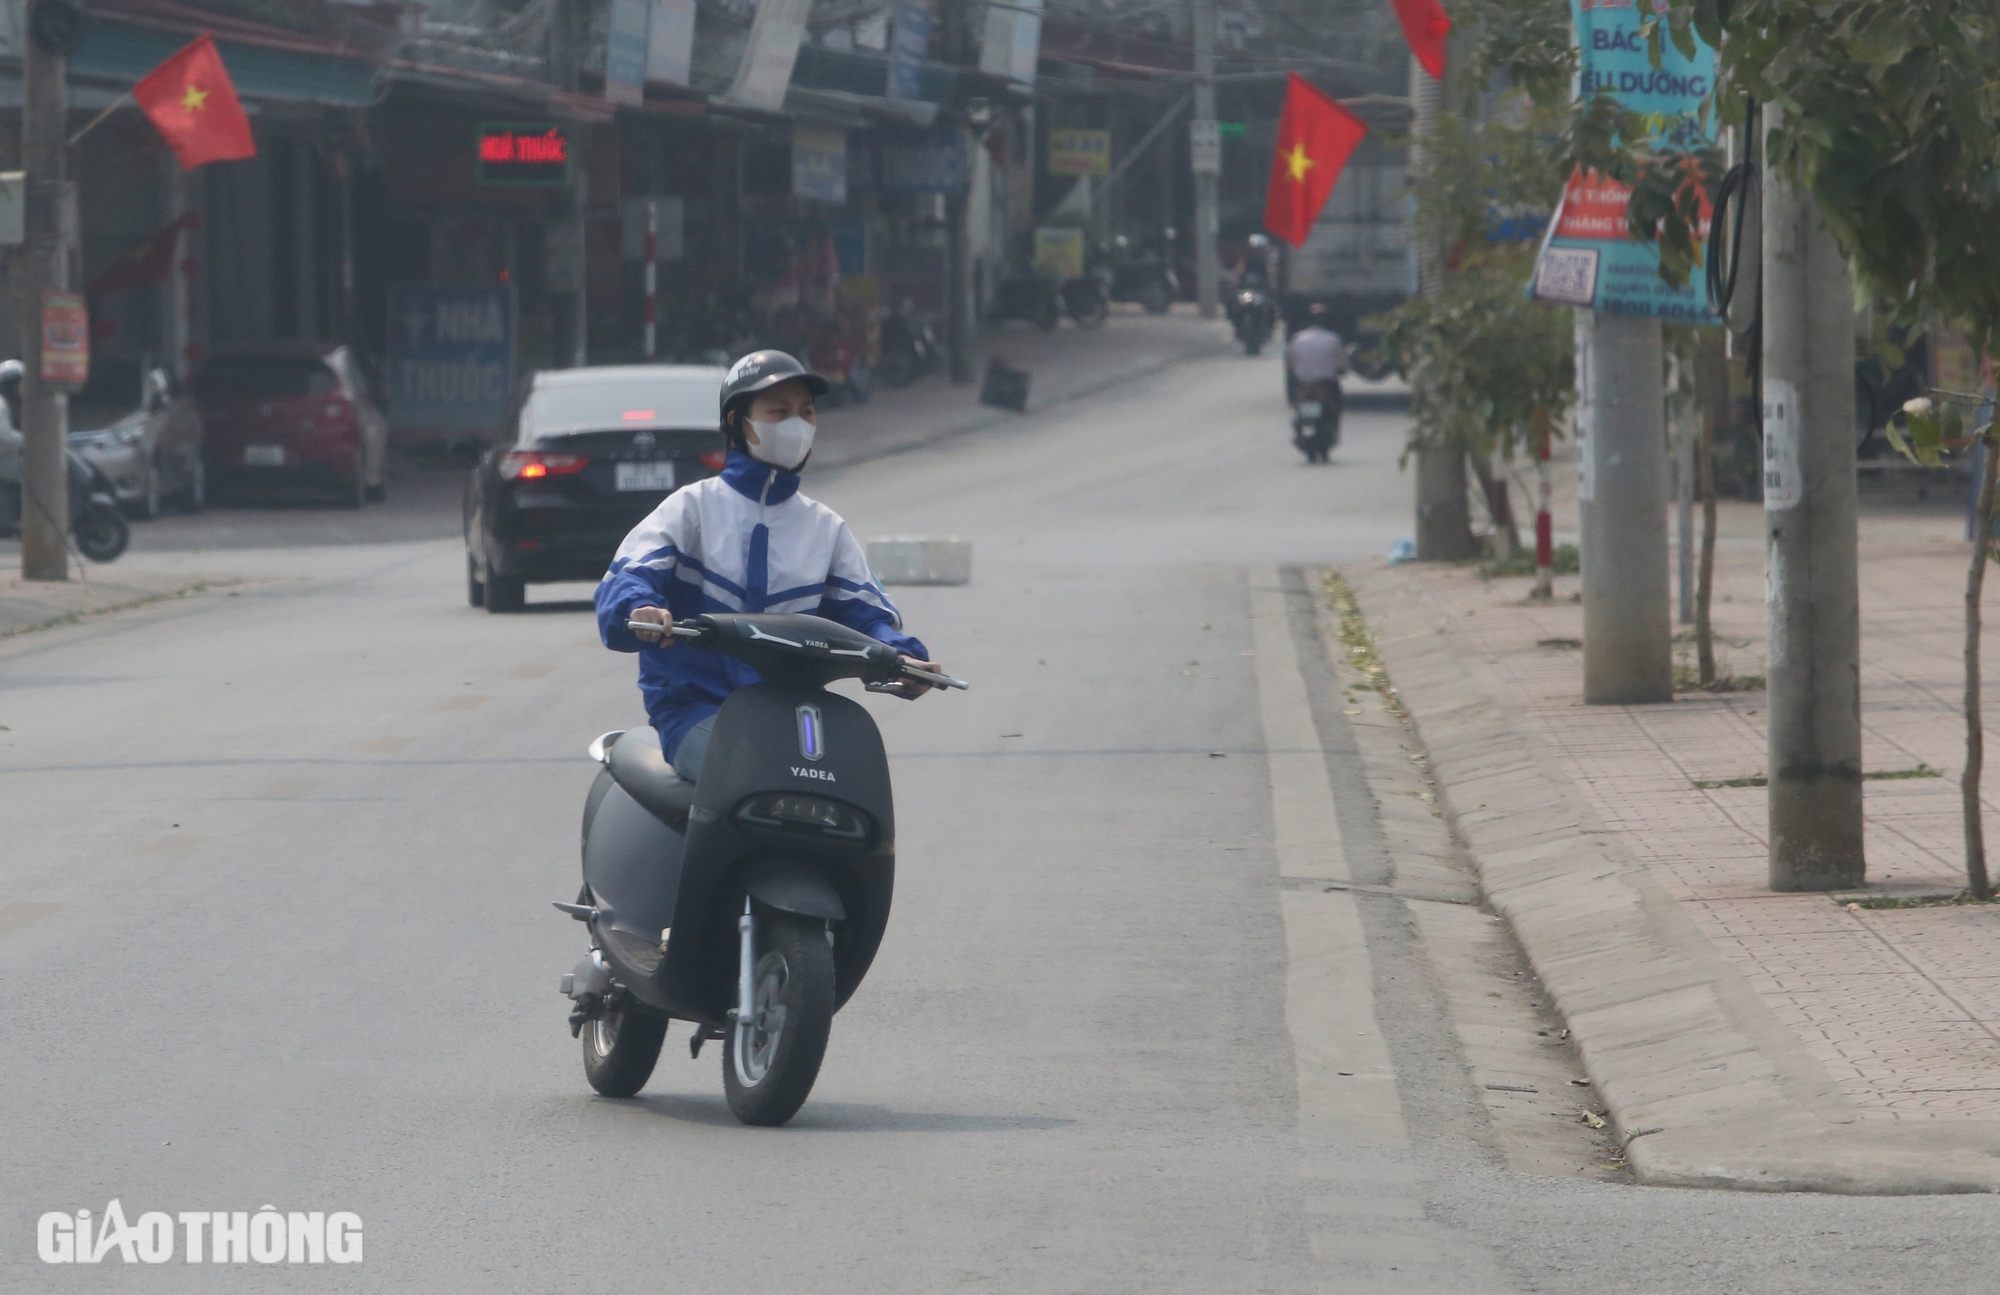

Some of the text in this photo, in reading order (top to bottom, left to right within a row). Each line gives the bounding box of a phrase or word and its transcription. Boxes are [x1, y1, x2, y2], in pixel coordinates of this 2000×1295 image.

[1593, 24, 1642, 52] BÁC
[805, 639, 829, 649] YADEA
[790, 766, 836, 782] YADEA
